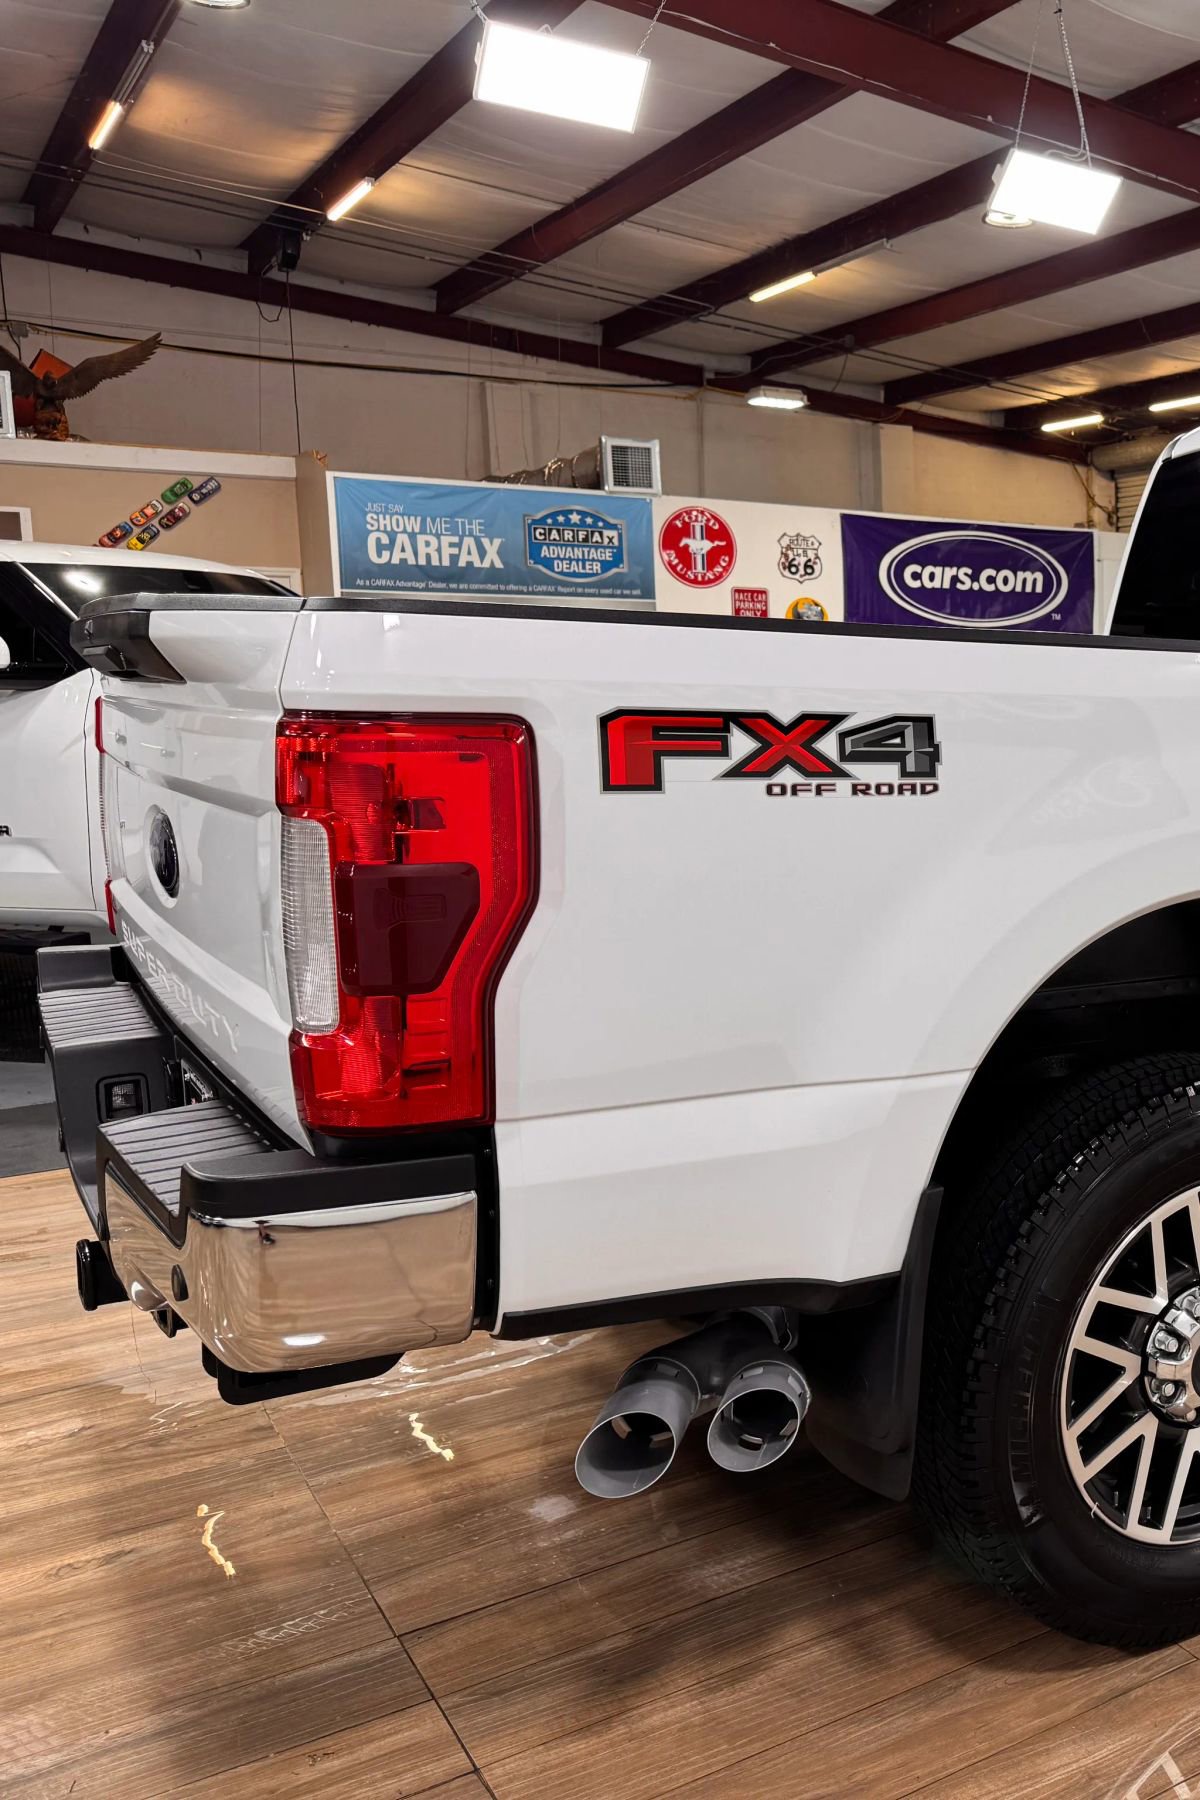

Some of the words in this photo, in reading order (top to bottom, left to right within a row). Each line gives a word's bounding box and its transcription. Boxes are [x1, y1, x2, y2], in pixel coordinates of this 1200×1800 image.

[365, 502, 385, 512] JUST
[388, 504, 404, 513] SAY
[366, 513, 421, 533] SHOW
[426, 516, 451, 534] ME
[454, 518, 485, 536] THE
[674, 511, 719, 530] FORD
[535, 528, 615, 545] CARFAX
[367, 531, 504, 568] CARFAX
[541, 545, 613, 560] ADVANTAGE
[553, 560, 602, 573] DEALER
[663, 550, 729, 581] MUSTANG
[788, 557, 815, 575] 66
[371, 578, 394, 587] CARFAX
[903, 563, 1044, 593] cars.com
[735, 601, 766, 610] PARKING
[597, 706, 941, 793] FX4
[766, 783, 837, 797] OFF
[851, 782, 940, 797] ROAD
[121, 919, 171, 992] SUPER
[171, 972, 240, 1054] DUTY
